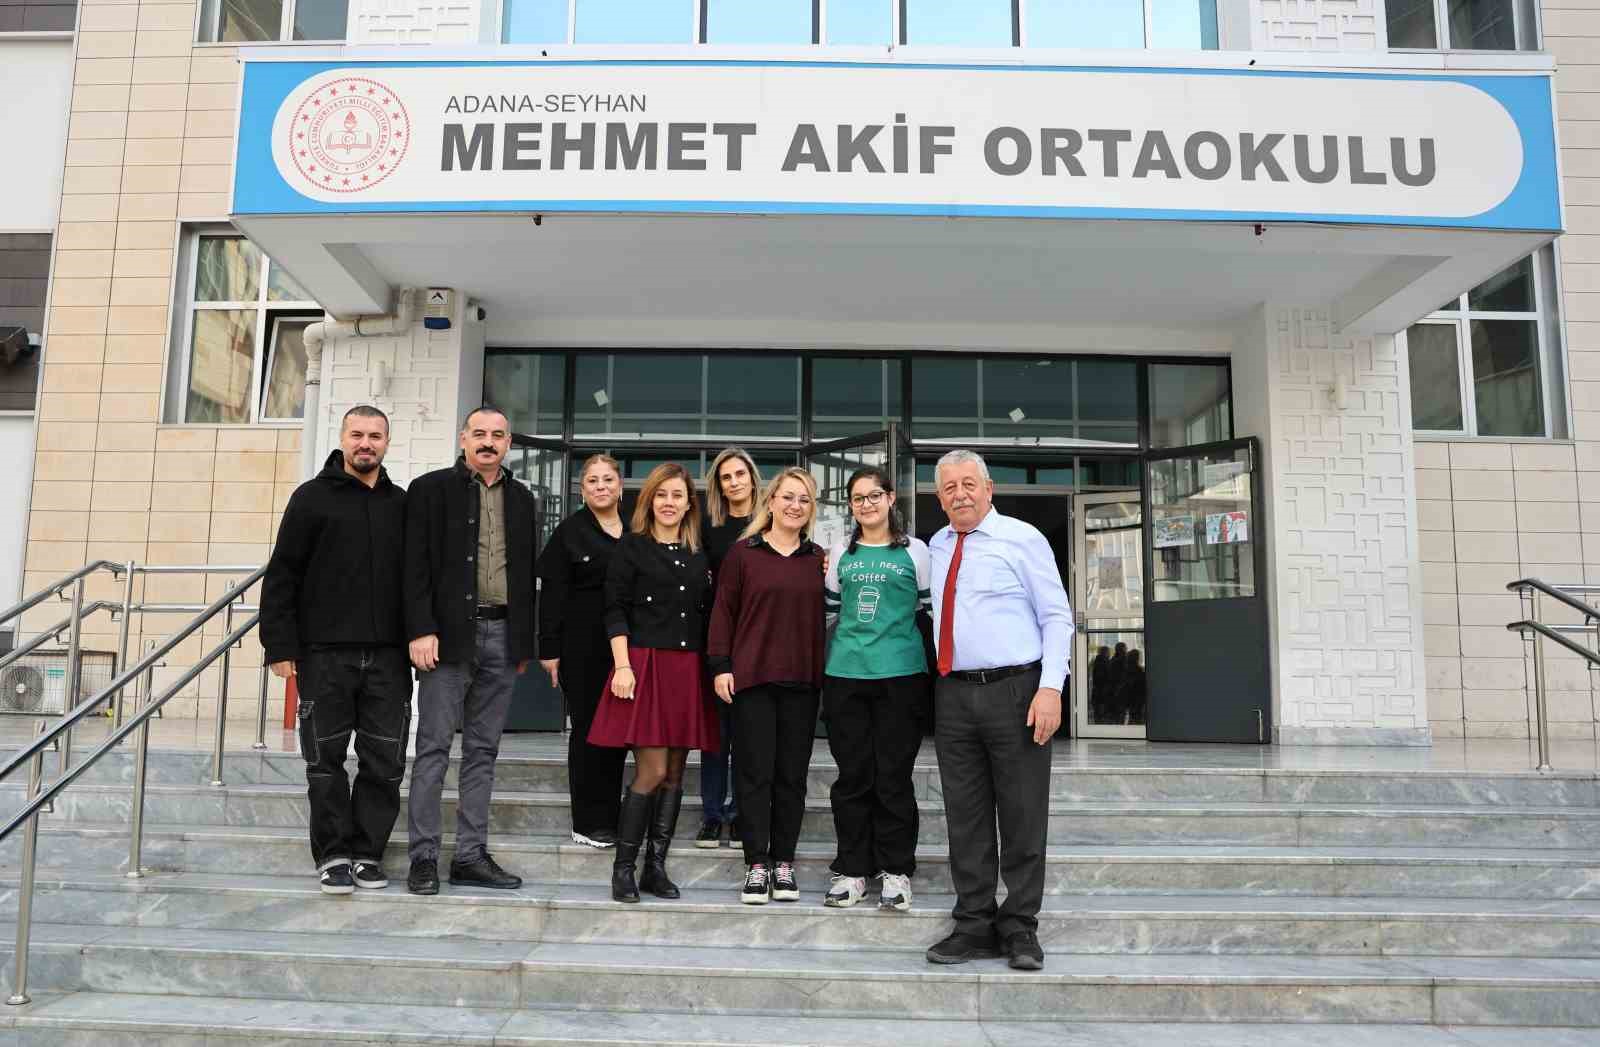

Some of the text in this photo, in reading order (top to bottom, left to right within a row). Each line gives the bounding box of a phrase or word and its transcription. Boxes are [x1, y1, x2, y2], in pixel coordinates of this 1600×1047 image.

[445, 94, 647, 113] ADANA-SEYHAN
[441, 112, 1436, 187] MEHMET AKİF ORTAOKULU
[880, 561, 905, 575] need
[851, 573, 887, 583] Coffee
